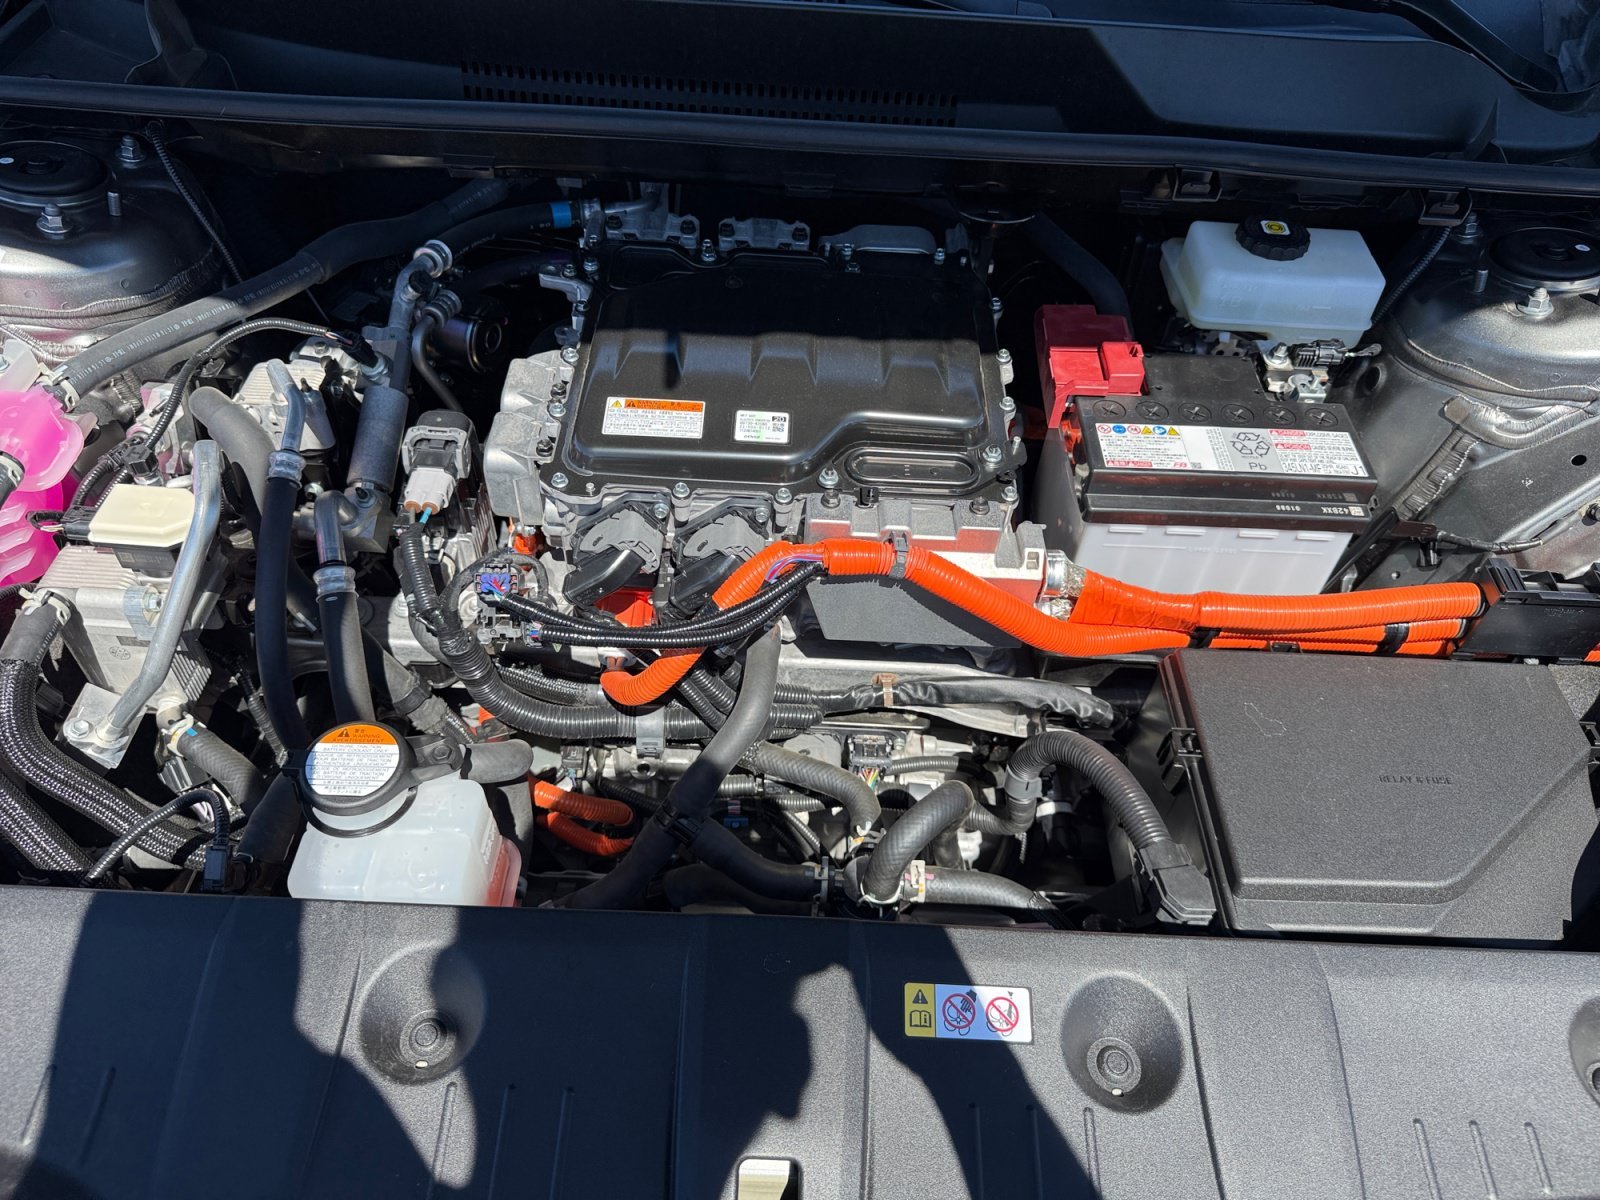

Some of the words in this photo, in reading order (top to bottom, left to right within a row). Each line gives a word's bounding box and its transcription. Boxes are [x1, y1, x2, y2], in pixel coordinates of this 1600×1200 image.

[1248, 462, 1268, 471] Pb
[1378, 774, 1412, 784] RELAY
[1425, 776, 1454, 785] FUSE
